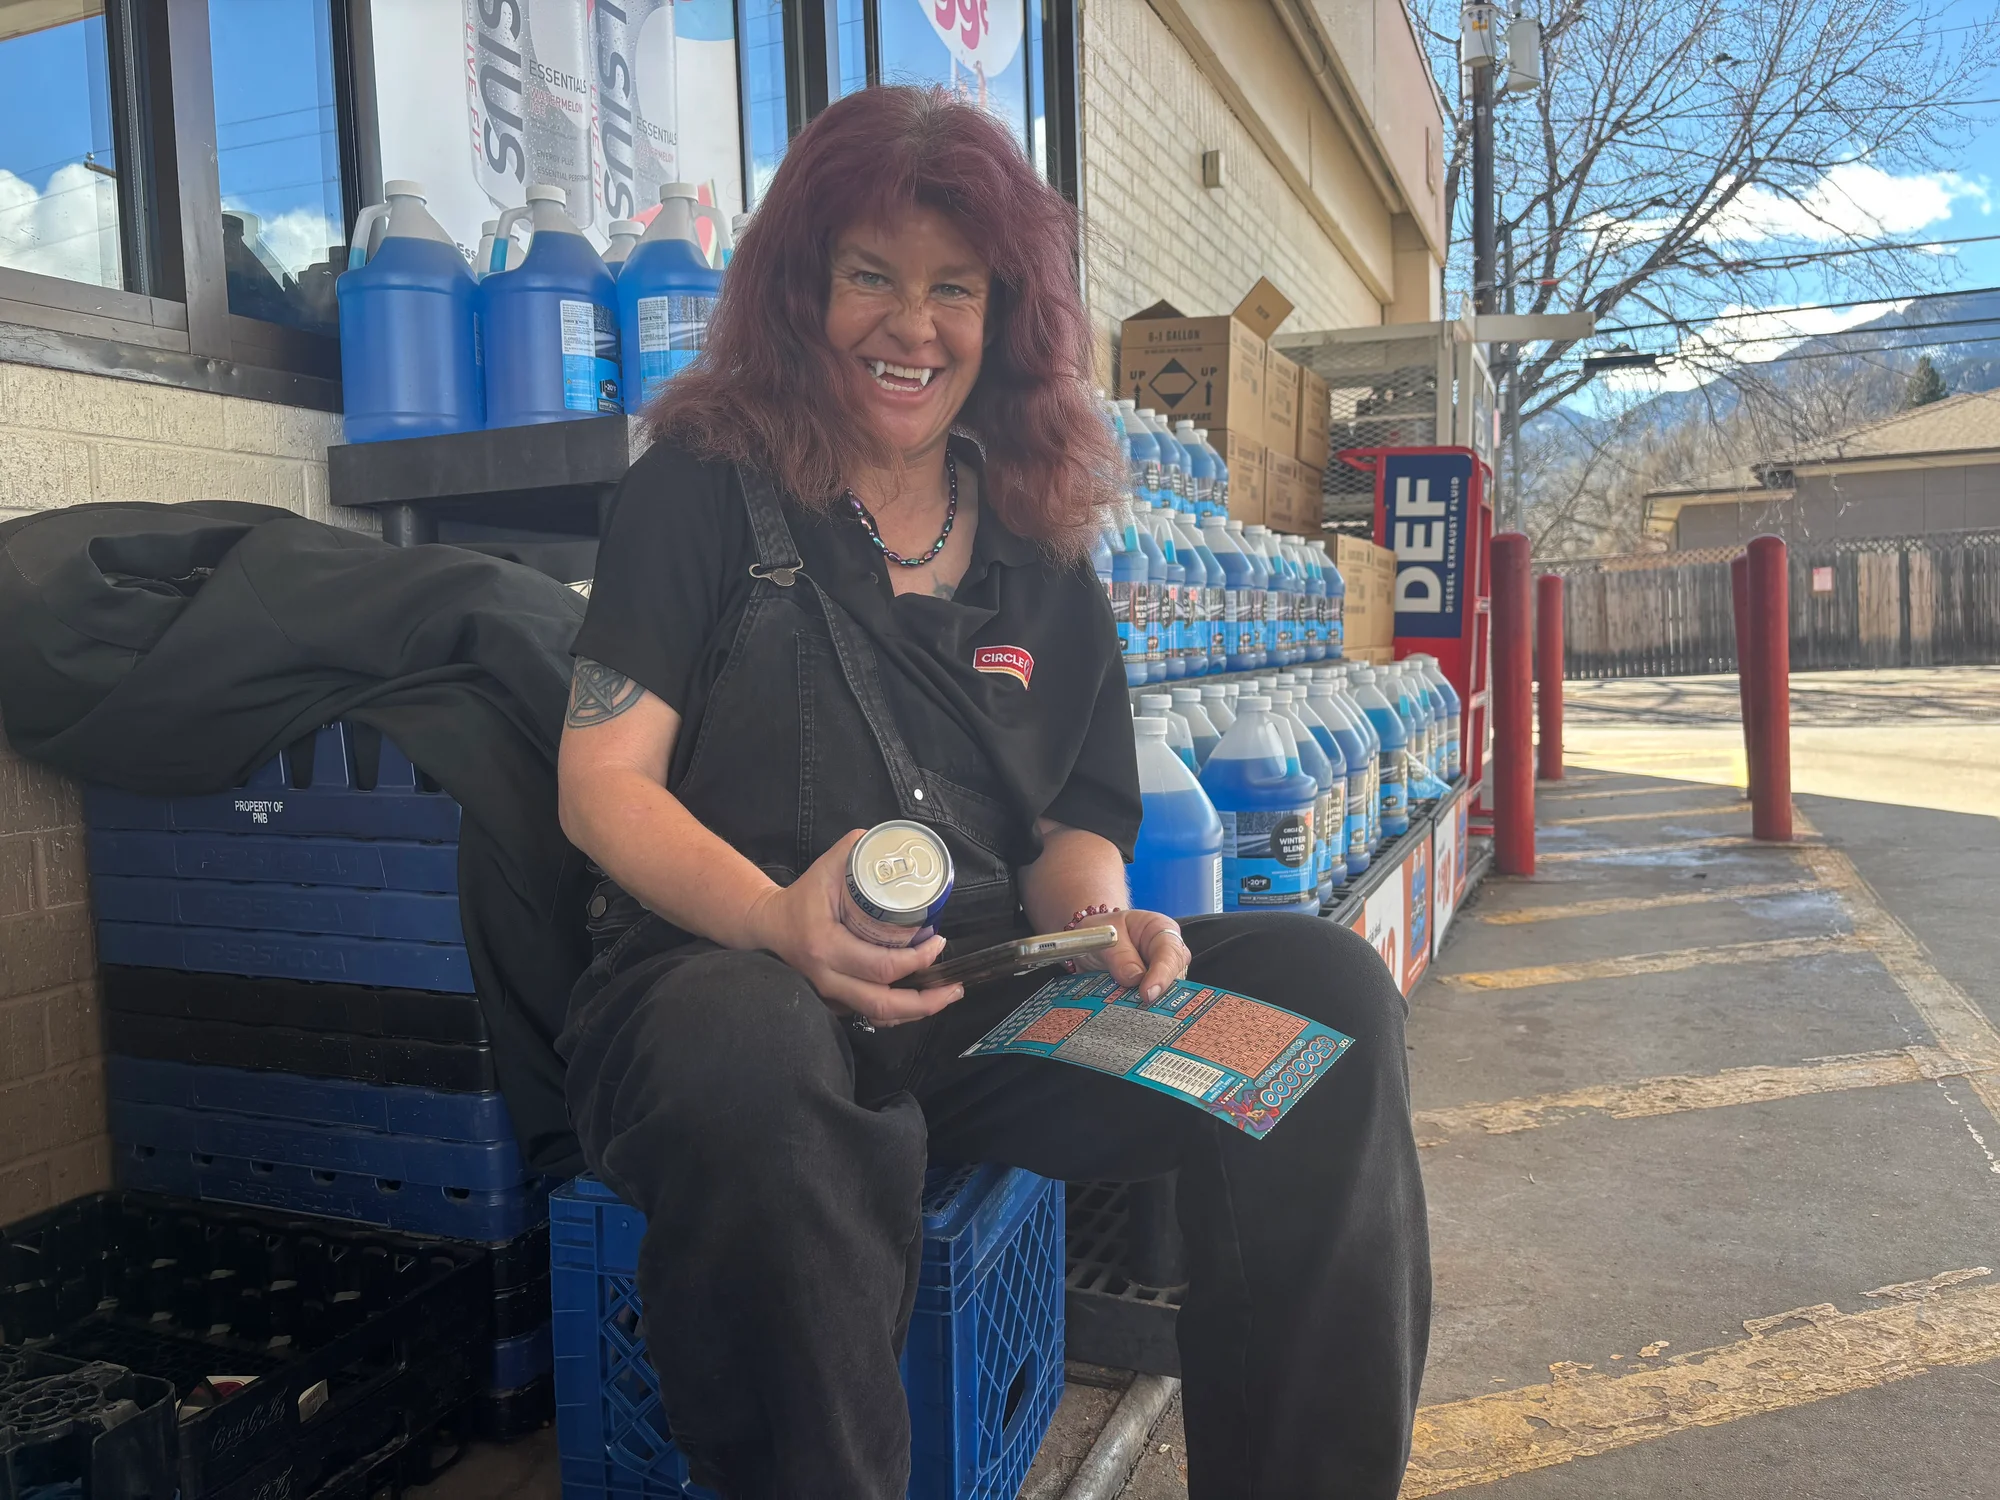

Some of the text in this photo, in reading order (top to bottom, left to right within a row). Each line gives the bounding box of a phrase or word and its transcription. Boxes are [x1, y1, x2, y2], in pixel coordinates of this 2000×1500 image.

[529, 59, 587, 94] ESSENTIALS
[466, 22, 482, 162] LIVE FIT
[529, 86, 583, 114] WATERMELON
[636, 116, 678, 146] ESSENTIALS
[536, 149, 575, 167] ENERGY PLUS
[537, 166, 567, 181] ESSENTIAL
[593, 160, 602, 208] FIT
[1167, 330, 1200, 342] GALLON
[1130, 370, 1146, 380] UP
[1201, 366, 1218, 376] UP
[1190, 412, 1211, 421] CARE
[1394, 476, 1446, 613] DEF
[1445, 476, 1460, 613] DIESEL EXHAUST FLUID
[981, 653, 1024, 668] CIRCLE
[234, 800, 283, 812] PROPERTY OF
[252, 812, 268, 823] PNB
[1279, 836, 1306, 845] WINTER
[1283, 844, 1305, 853] BLEND
[862, 901, 875, 913] OZ
[1170, 991, 1191, 1008] PRIZE
[1254, 1038, 1306, 1089] CROSSWORD
[1260, 1036, 1337, 1107] $500,000
